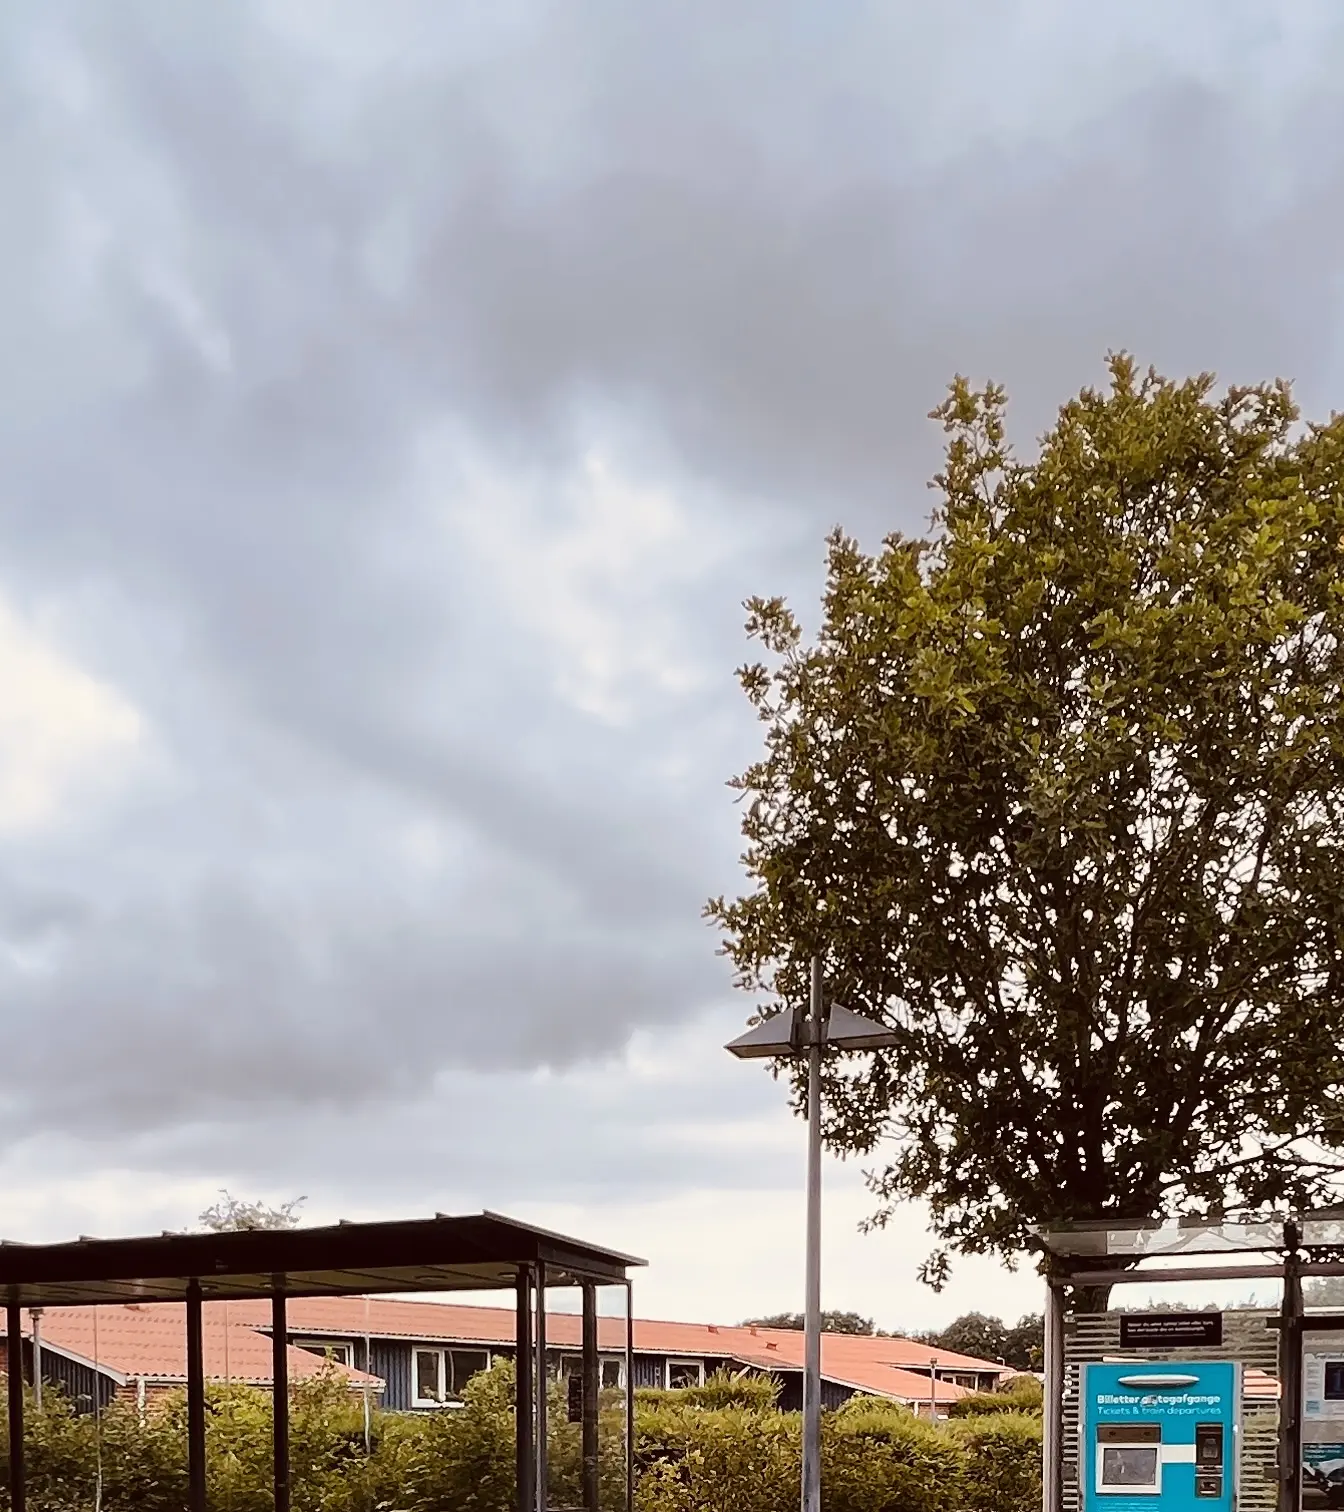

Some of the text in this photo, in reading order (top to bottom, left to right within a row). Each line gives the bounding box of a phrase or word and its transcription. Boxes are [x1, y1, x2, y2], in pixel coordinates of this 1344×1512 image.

[1097, 1394, 1140, 1404] Billetter
[1098, 1406, 1222, 1416] Tickets & train departures
